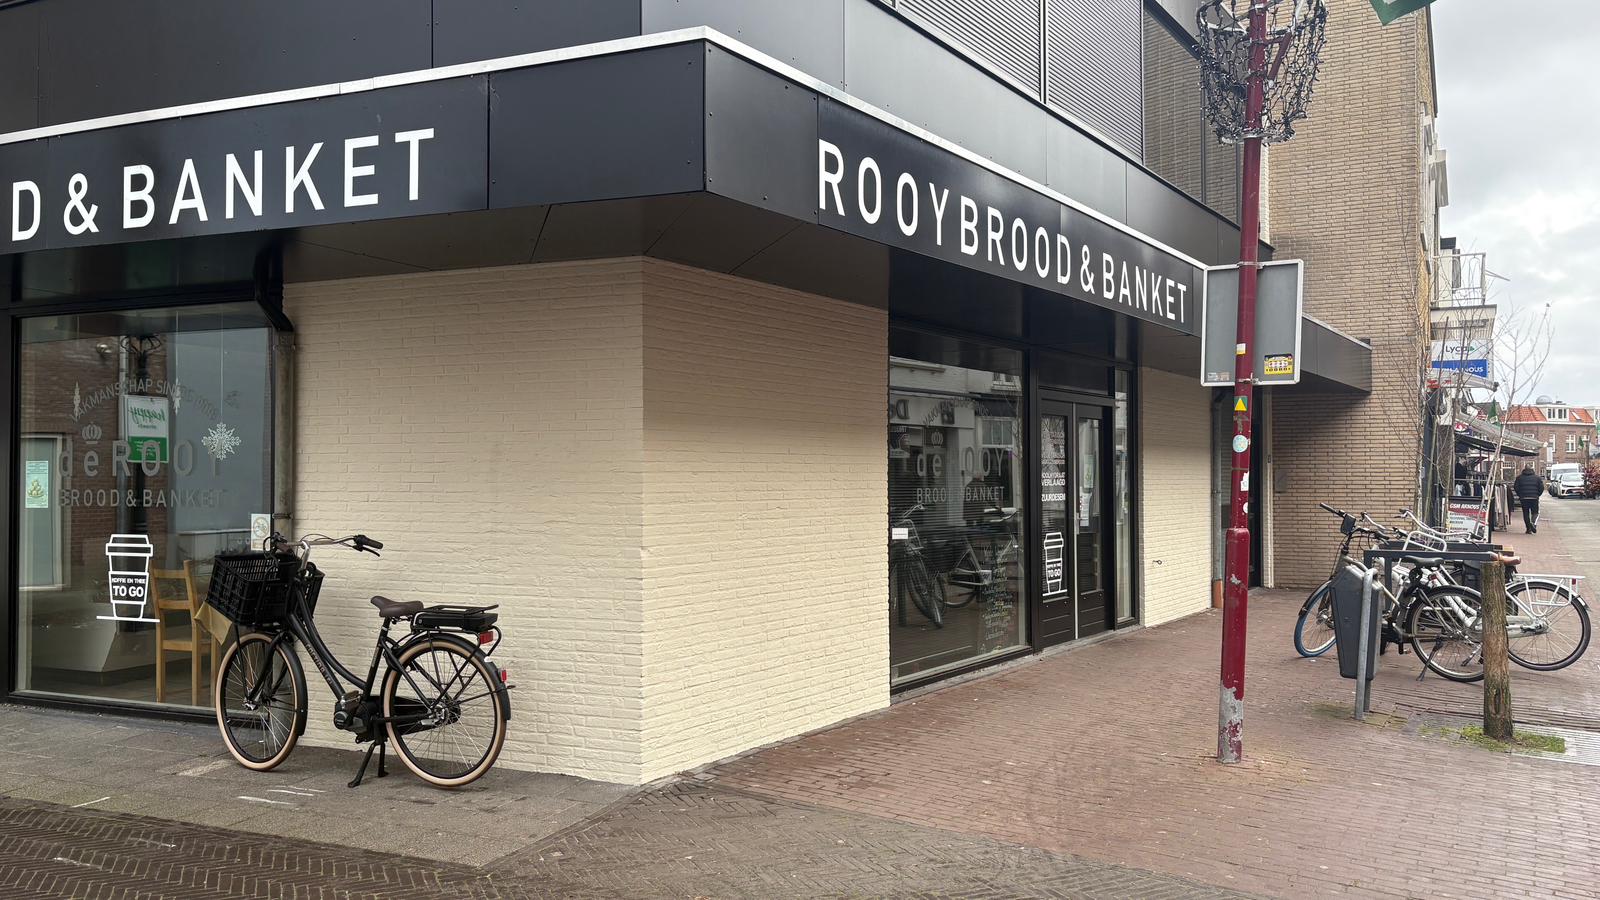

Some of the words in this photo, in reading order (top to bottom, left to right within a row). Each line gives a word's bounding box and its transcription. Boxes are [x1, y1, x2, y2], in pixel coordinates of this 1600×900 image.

[63, 172, 100, 236] &
[122, 127, 435, 230] BANKET
[1080, 244, 1095, 295] &
[1102, 252, 1187, 324] BANKET
[60, 489, 120, 507] BROOD
[125, 489, 137, 508] &
[142, 489, 222, 507] BANKET
[916, 487, 951, 503] BROO
[965, 486, 1005, 501] BANKET
[113, 585, 127, 597] TO
[129, 586, 144, 598] GO
